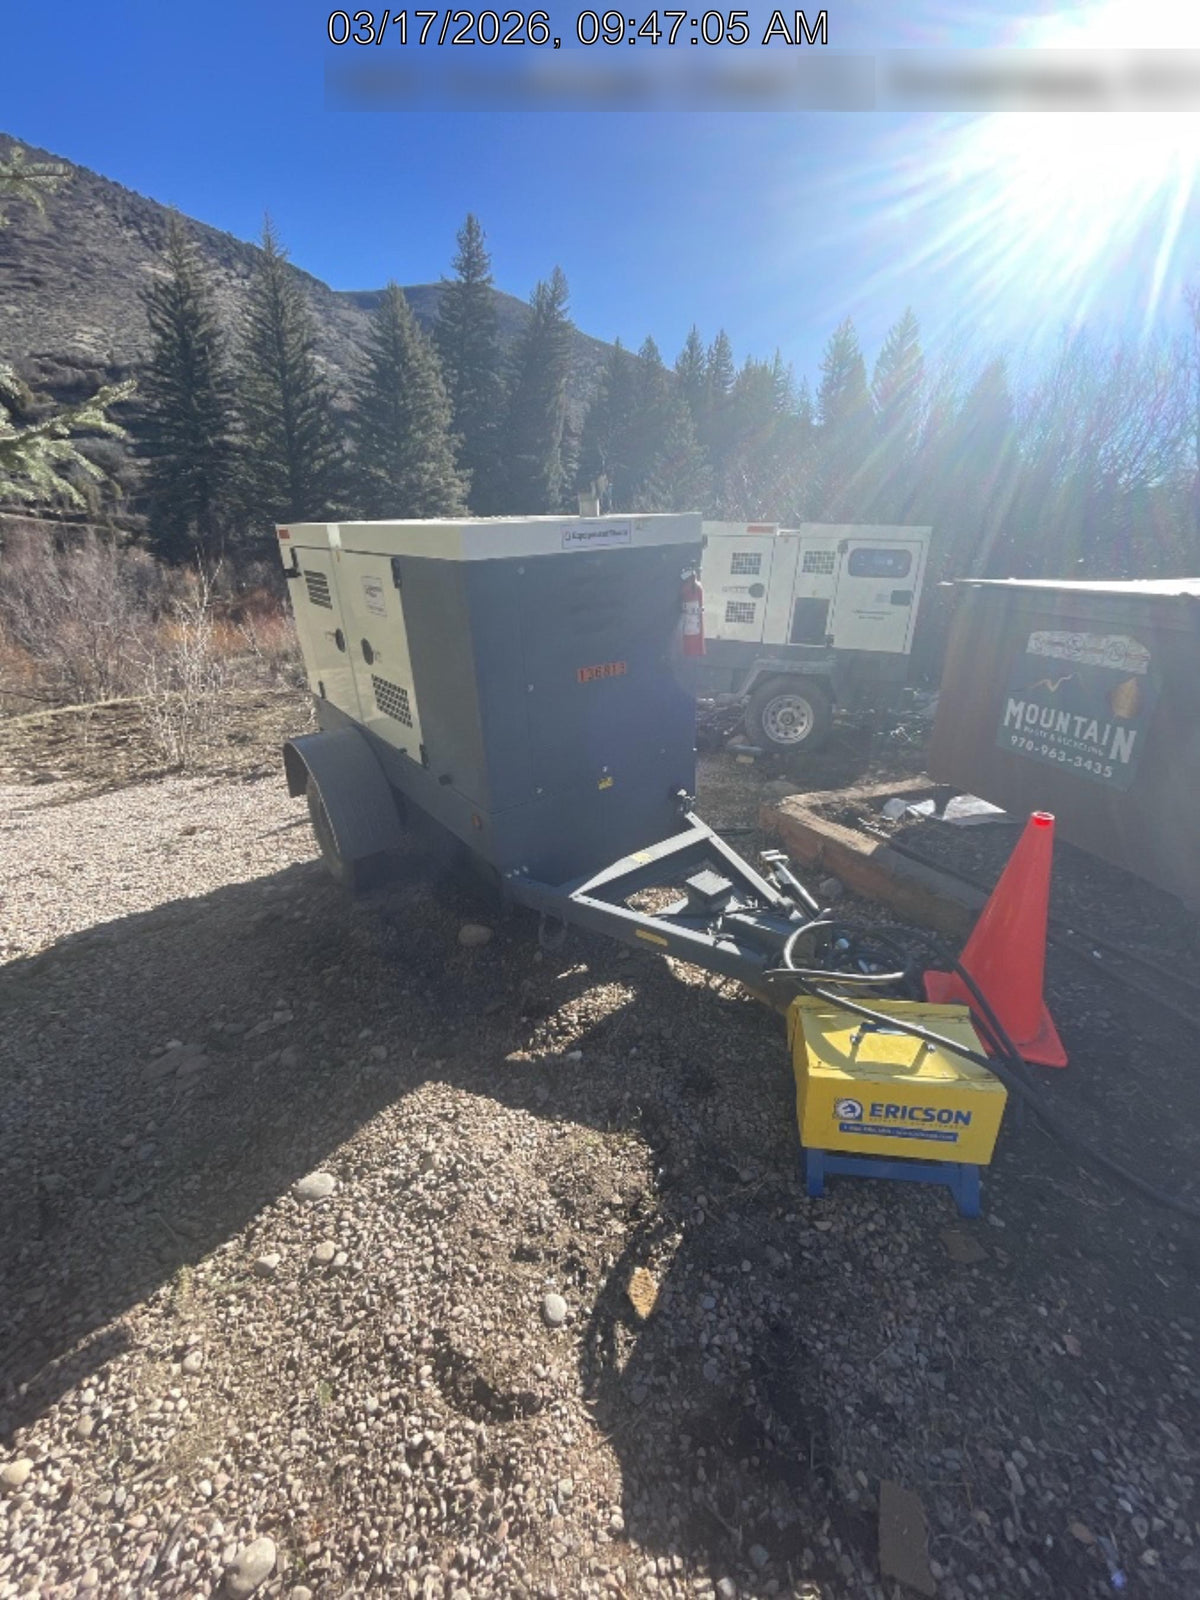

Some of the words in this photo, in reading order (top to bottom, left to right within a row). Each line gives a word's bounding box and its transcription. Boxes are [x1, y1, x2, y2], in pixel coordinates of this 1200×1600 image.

[1003, 697, 1138, 764] MOUNTAIN
[1010, 735, 1114, 779] 970-963-3435
[869, 1102, 972, 1126] ERICSON
